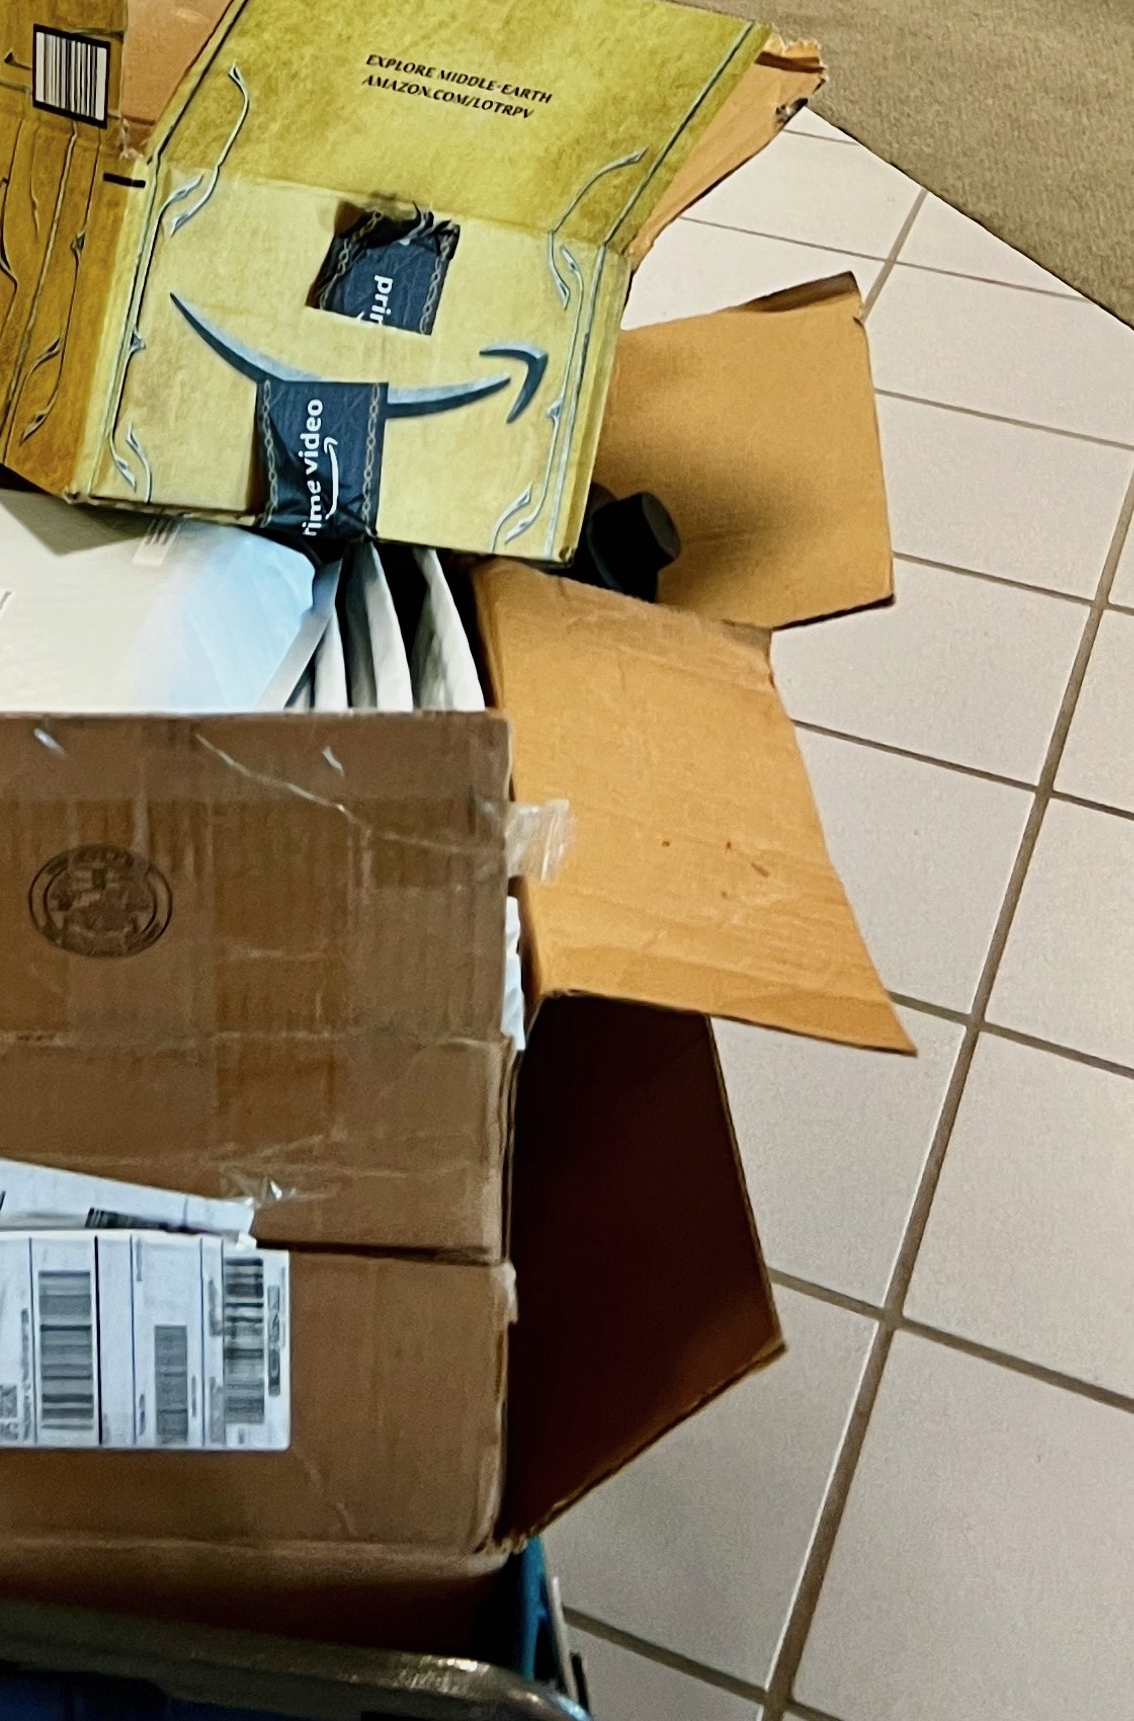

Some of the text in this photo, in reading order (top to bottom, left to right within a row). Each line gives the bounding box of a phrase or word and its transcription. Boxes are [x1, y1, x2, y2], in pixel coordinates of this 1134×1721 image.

[362, 74, 535, 119] AMAZON.COM/LOTRPV
[366, 54, 553, 104] EXPLORE MIDDLE-EARTH
[298, 398, 324, 536] rime video
